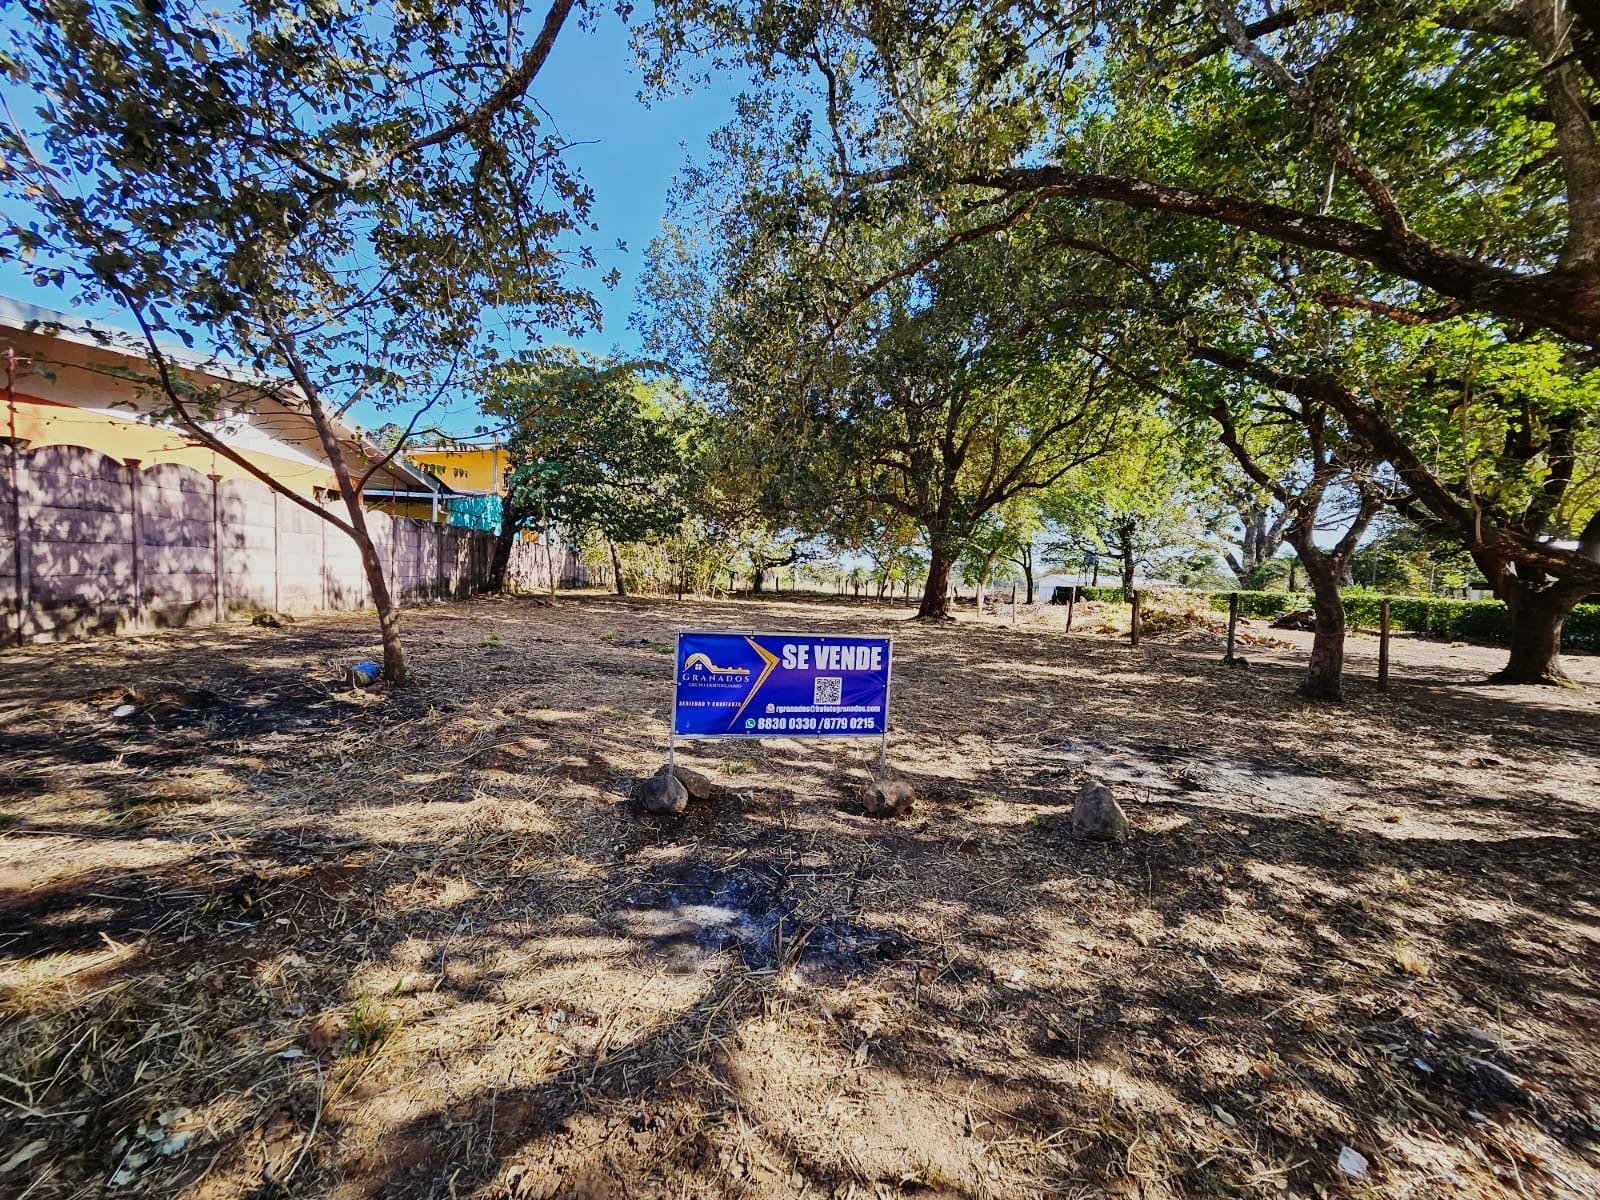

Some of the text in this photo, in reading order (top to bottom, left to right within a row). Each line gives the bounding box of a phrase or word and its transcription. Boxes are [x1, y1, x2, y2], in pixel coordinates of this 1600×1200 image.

[782, 644, 882, 671] SE VENDE
[682, 673, 750, 683] GRANADOS
[757, 717, 787, 730] 8830
[788, 717, 817, 730] 0330
[849, 717, 875, 729] 0215
